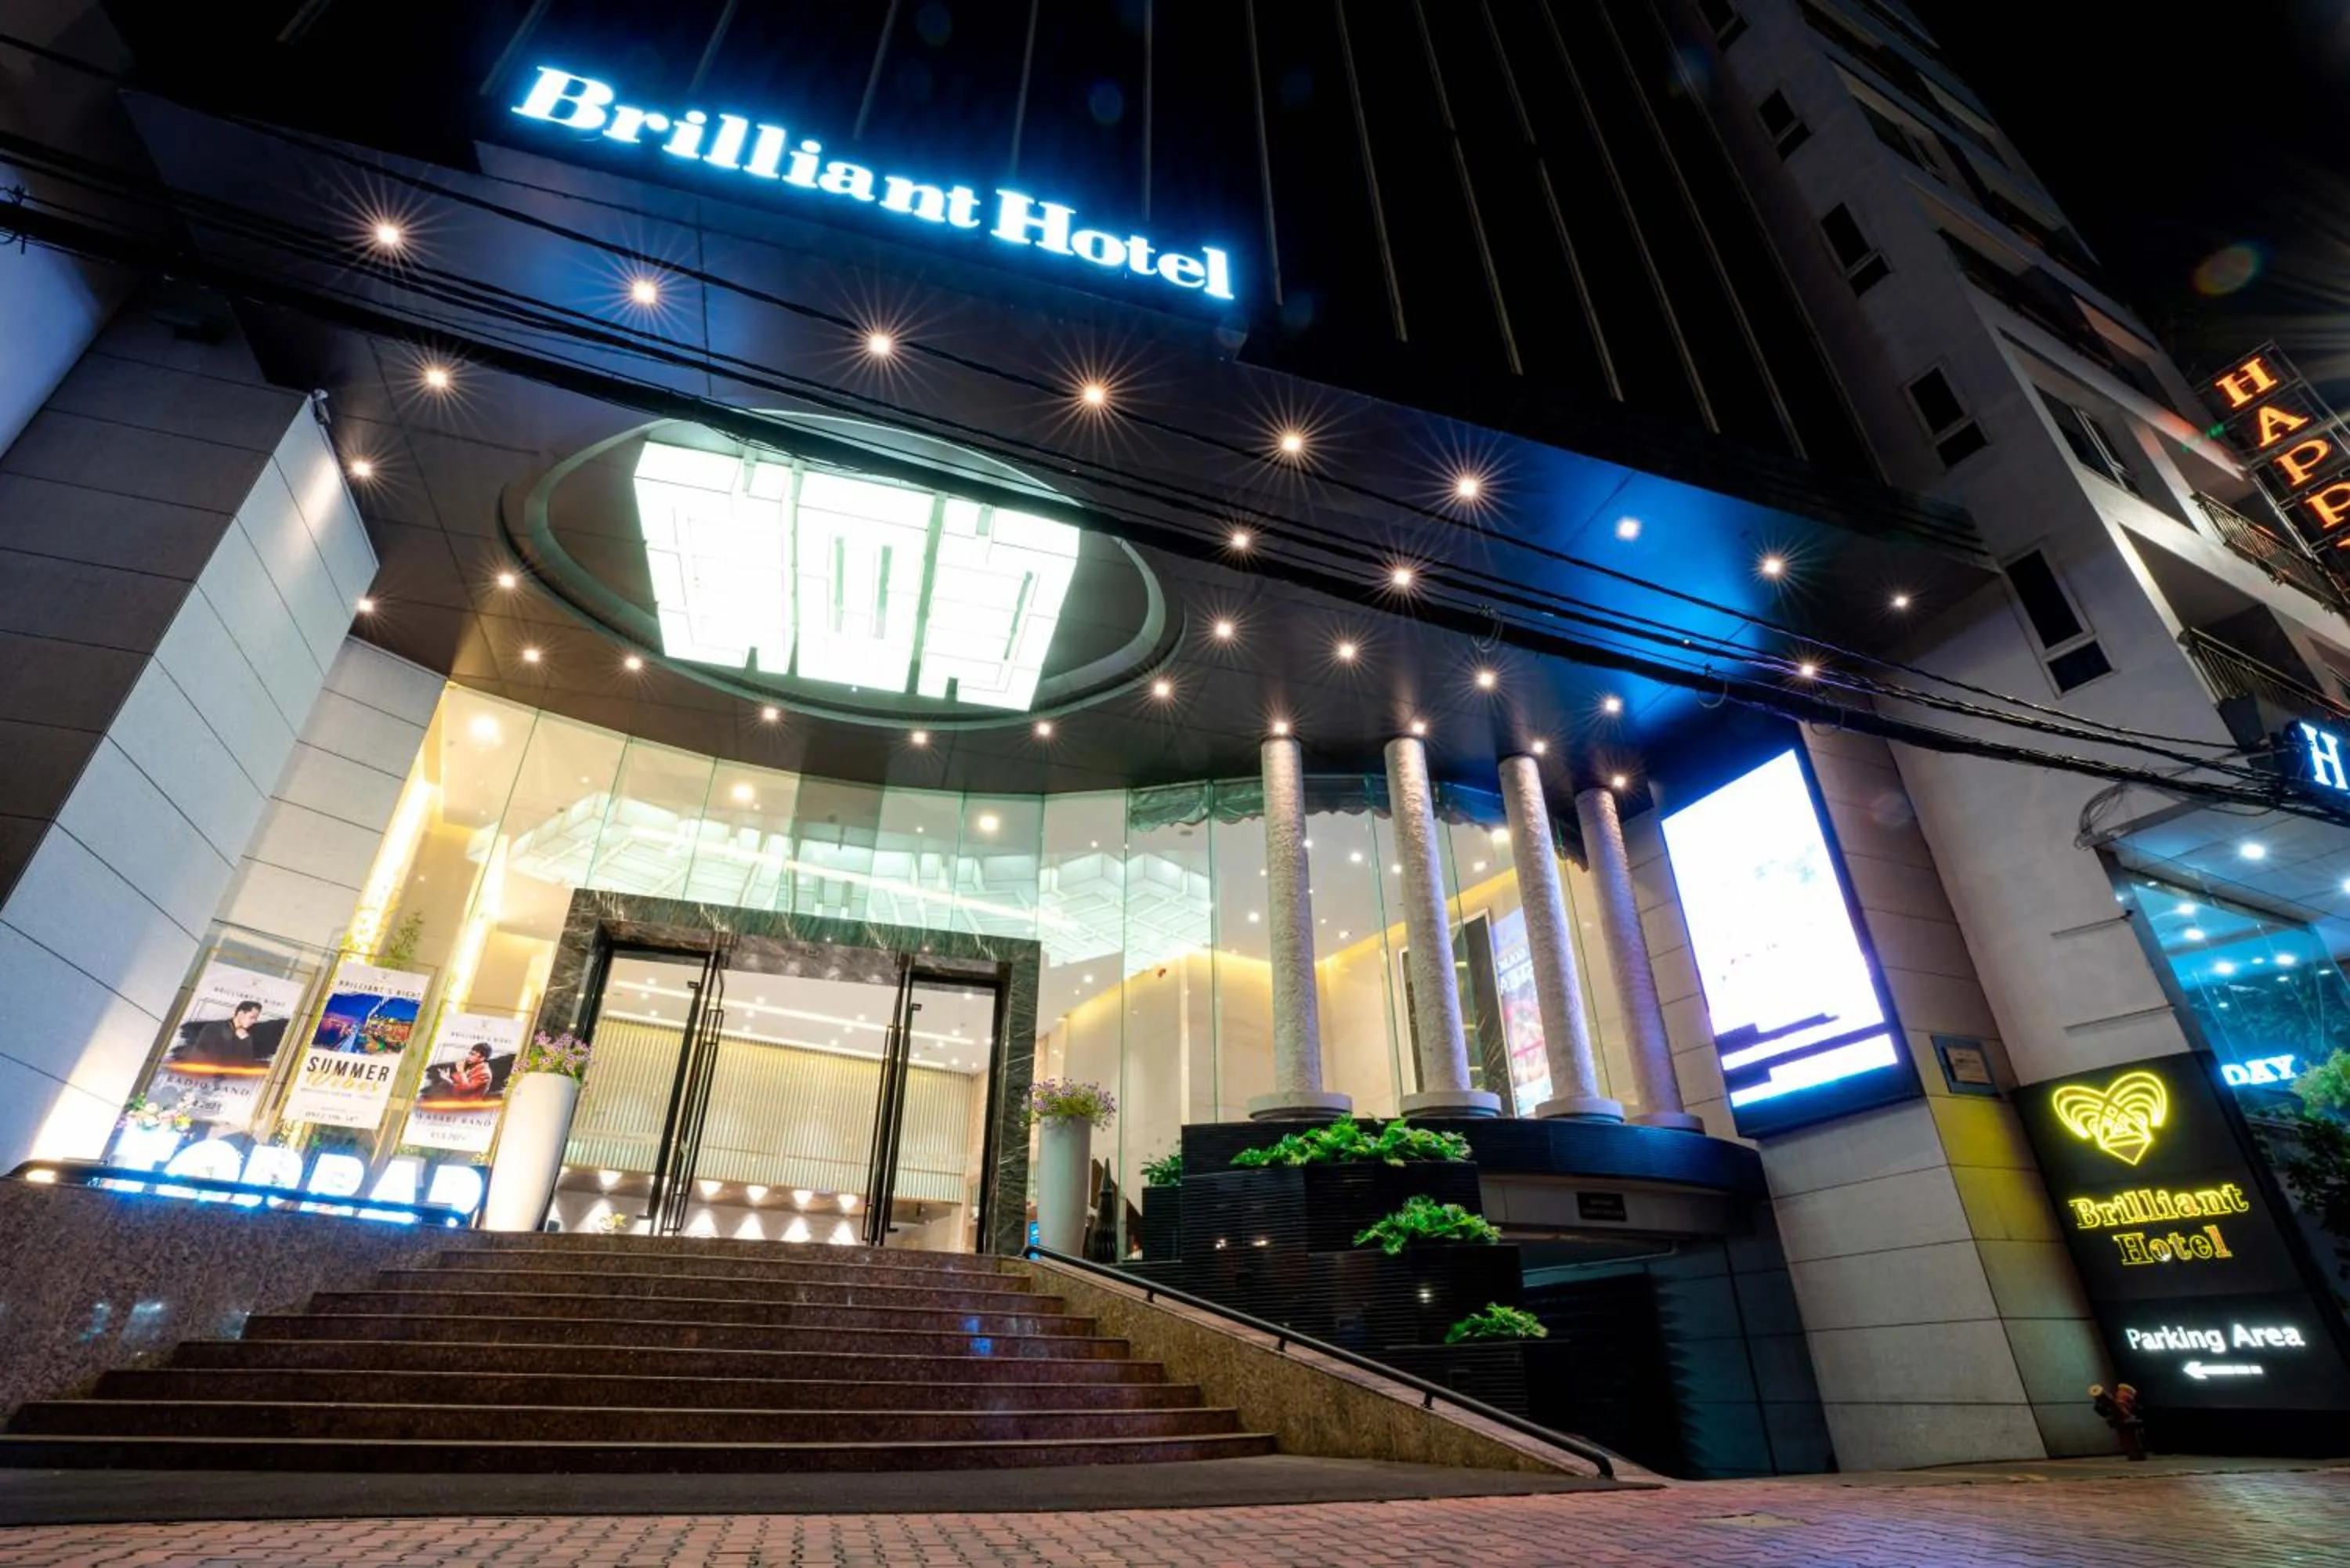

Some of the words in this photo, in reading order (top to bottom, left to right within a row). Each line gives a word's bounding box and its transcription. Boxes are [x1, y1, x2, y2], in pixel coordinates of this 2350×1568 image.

[511, 66, 981, 229] Brilliant
[990, 190, 1234, 299] Hotel
[2215, 357, 2350, 547] HAPP
[306, 1057, 390, 1082] SUMMER
[2222, 1054, 2296, 1086] DAY
[2069, 1183, 2249, 1229] Brilliant
[2113, 1225, 2232, 1266] Hotel
[2125, 1325, 2227, 1353] Parking
[2232, 1323, 2306, 1348] Area
